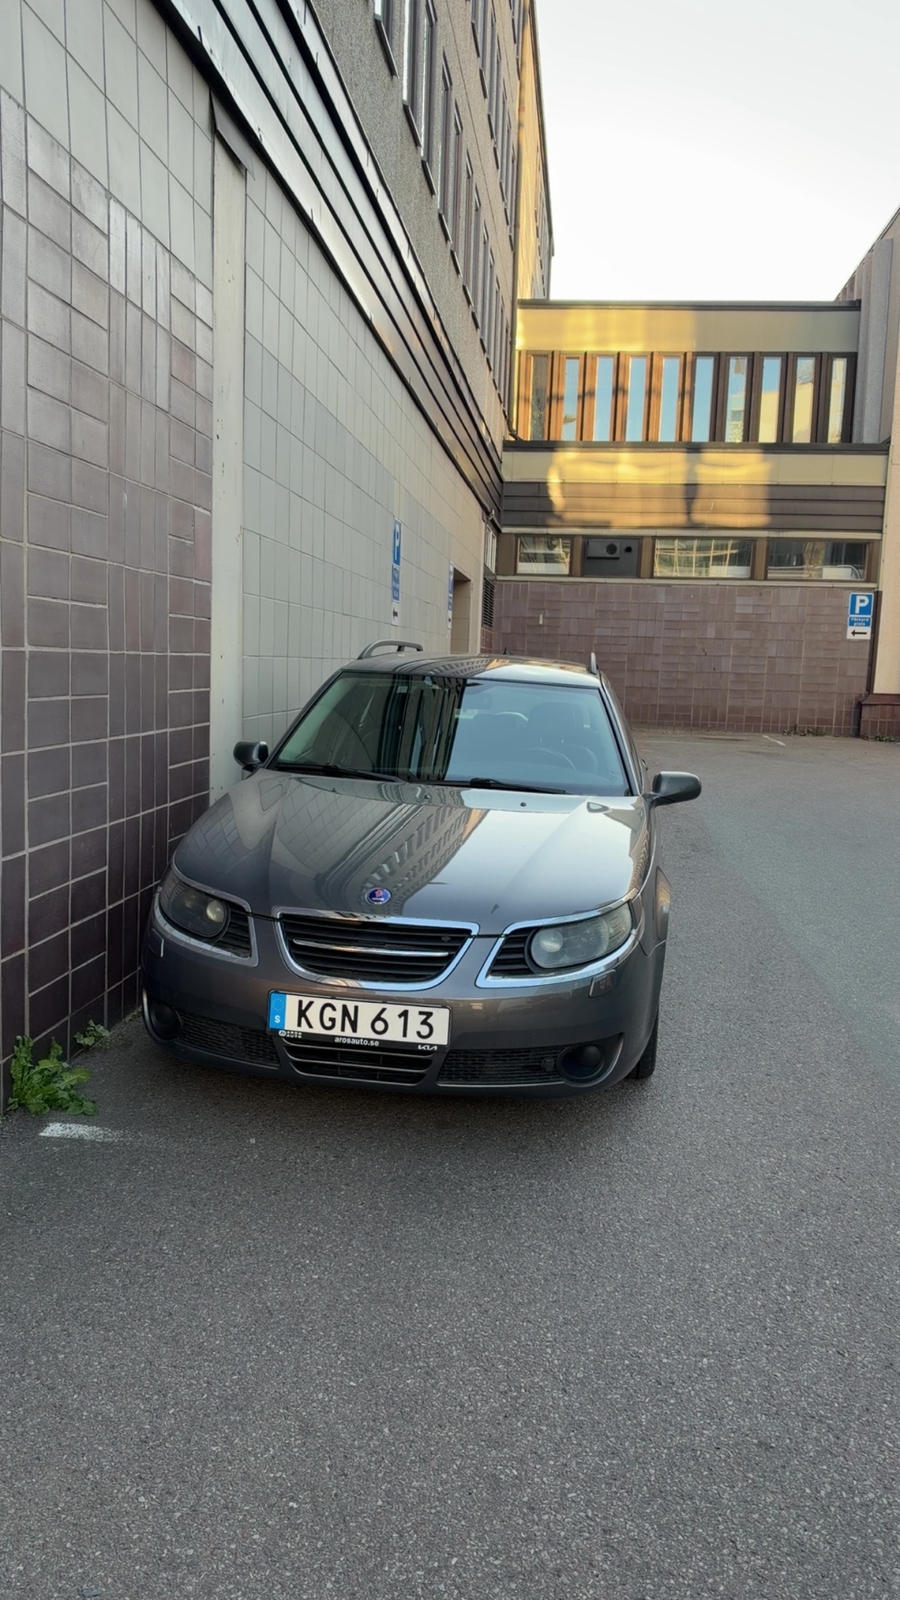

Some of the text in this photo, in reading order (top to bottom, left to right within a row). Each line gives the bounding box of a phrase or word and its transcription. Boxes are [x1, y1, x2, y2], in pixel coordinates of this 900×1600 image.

[394, 523, 400, 561] P
[855, 595, 870, 614] P
[274, 1014, 281, 1024] S
[297, 999, 434, 1040] KGN 613
[334, 1036, 380, 1047] arosauto.se
